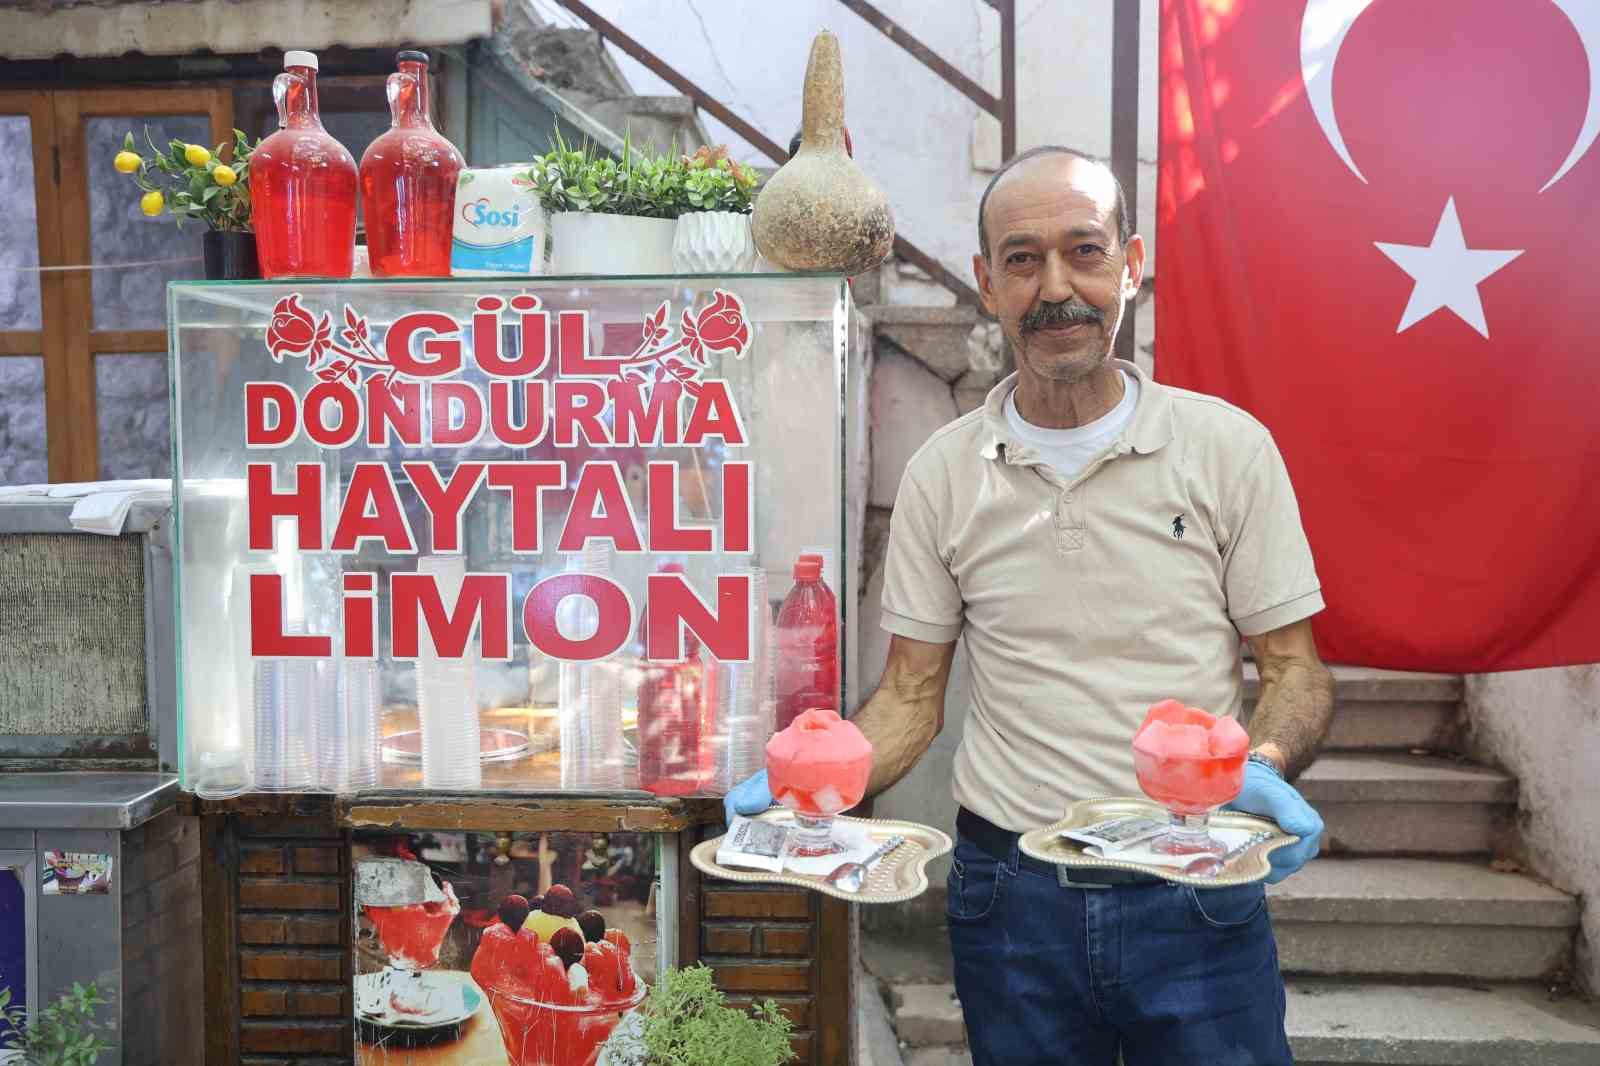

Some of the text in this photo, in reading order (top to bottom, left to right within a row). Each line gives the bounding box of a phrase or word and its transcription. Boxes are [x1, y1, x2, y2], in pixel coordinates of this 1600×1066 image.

[474, 202, 520, 227] Sosi
[385, 296, 622, 377] GÜL
[246, 382, 744, 445] DONDURMA
[248, 463, 752, 553] HAYTALI
